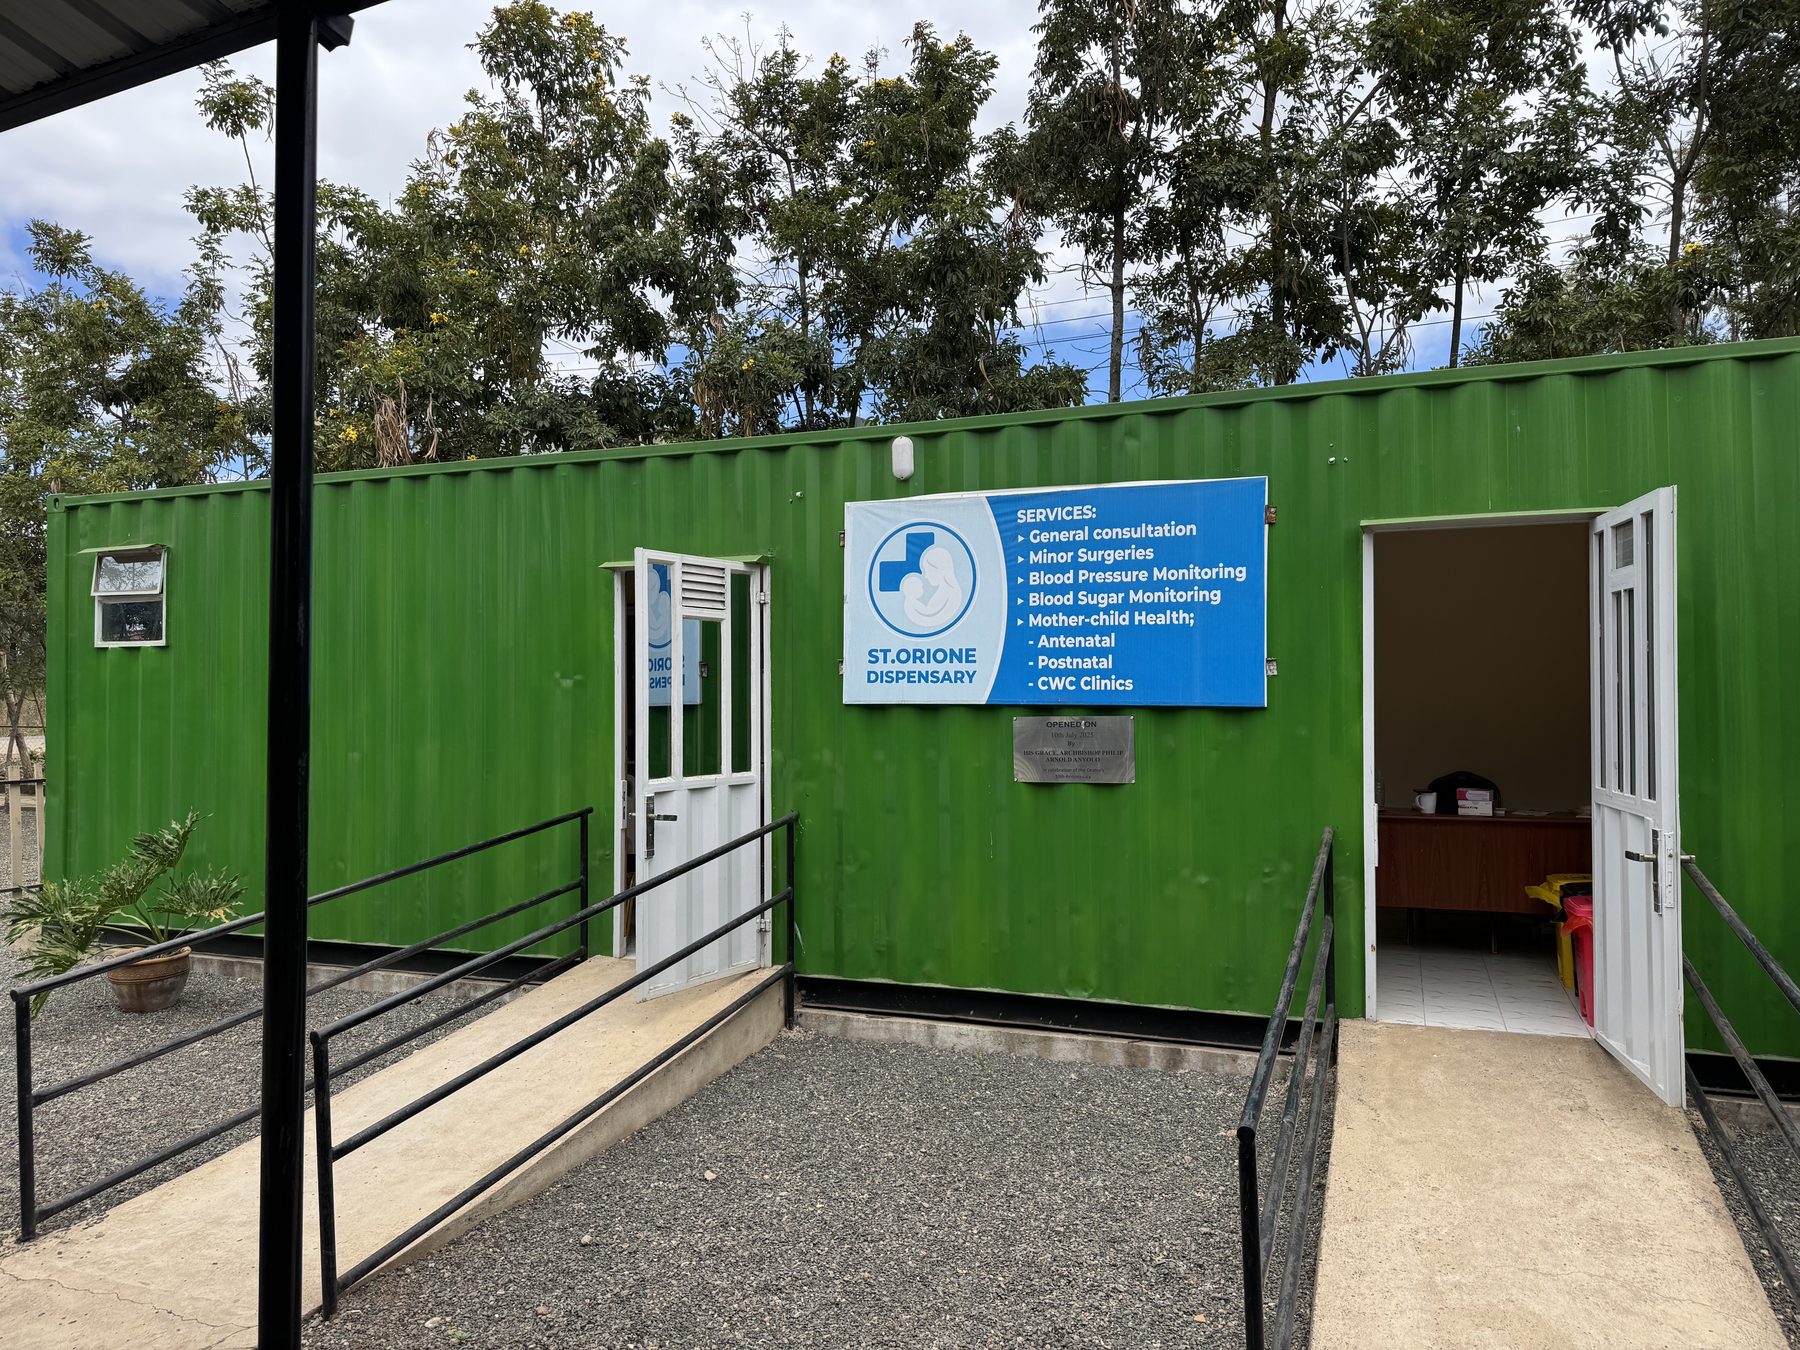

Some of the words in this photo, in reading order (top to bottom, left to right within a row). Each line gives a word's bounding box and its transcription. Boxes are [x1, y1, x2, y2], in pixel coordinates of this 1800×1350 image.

[1017, 505, 1097, 523] SERVICES:
[1029, 526, 1089, 544] General
[1093, 521, 1197, 540] consultation
[1029, 548, 1074, 564] Minor
[1077, 544, 1154, 565] Surgeries
[1029, 569, 1074, 585] Blood
[1078, 569, 1149, 584] Pressure
[1153, 562, 1247, 582] Monitoring
[1029, 591, 1074, 607] Blood
[1077, 590, 1125, 608] Sugar
[1129, 585, 1221, 605] Monitoring
[1029, 610, 1130, 627] Mother-child
[1134, 609, 1195, 627] Health;
[1037, 632, 1116, 648] Antenatal
[867, 647, 977, 665] ST.ORIONE
[1038, 654, 1113, 669] Postnatal
[866, 670, 977, 685] DISPENSARY
[1037, 676, 1076, 691] CWC
[1080, 674, 1134, 691] Clinics
[1084, 720, 1097, 728] ON
